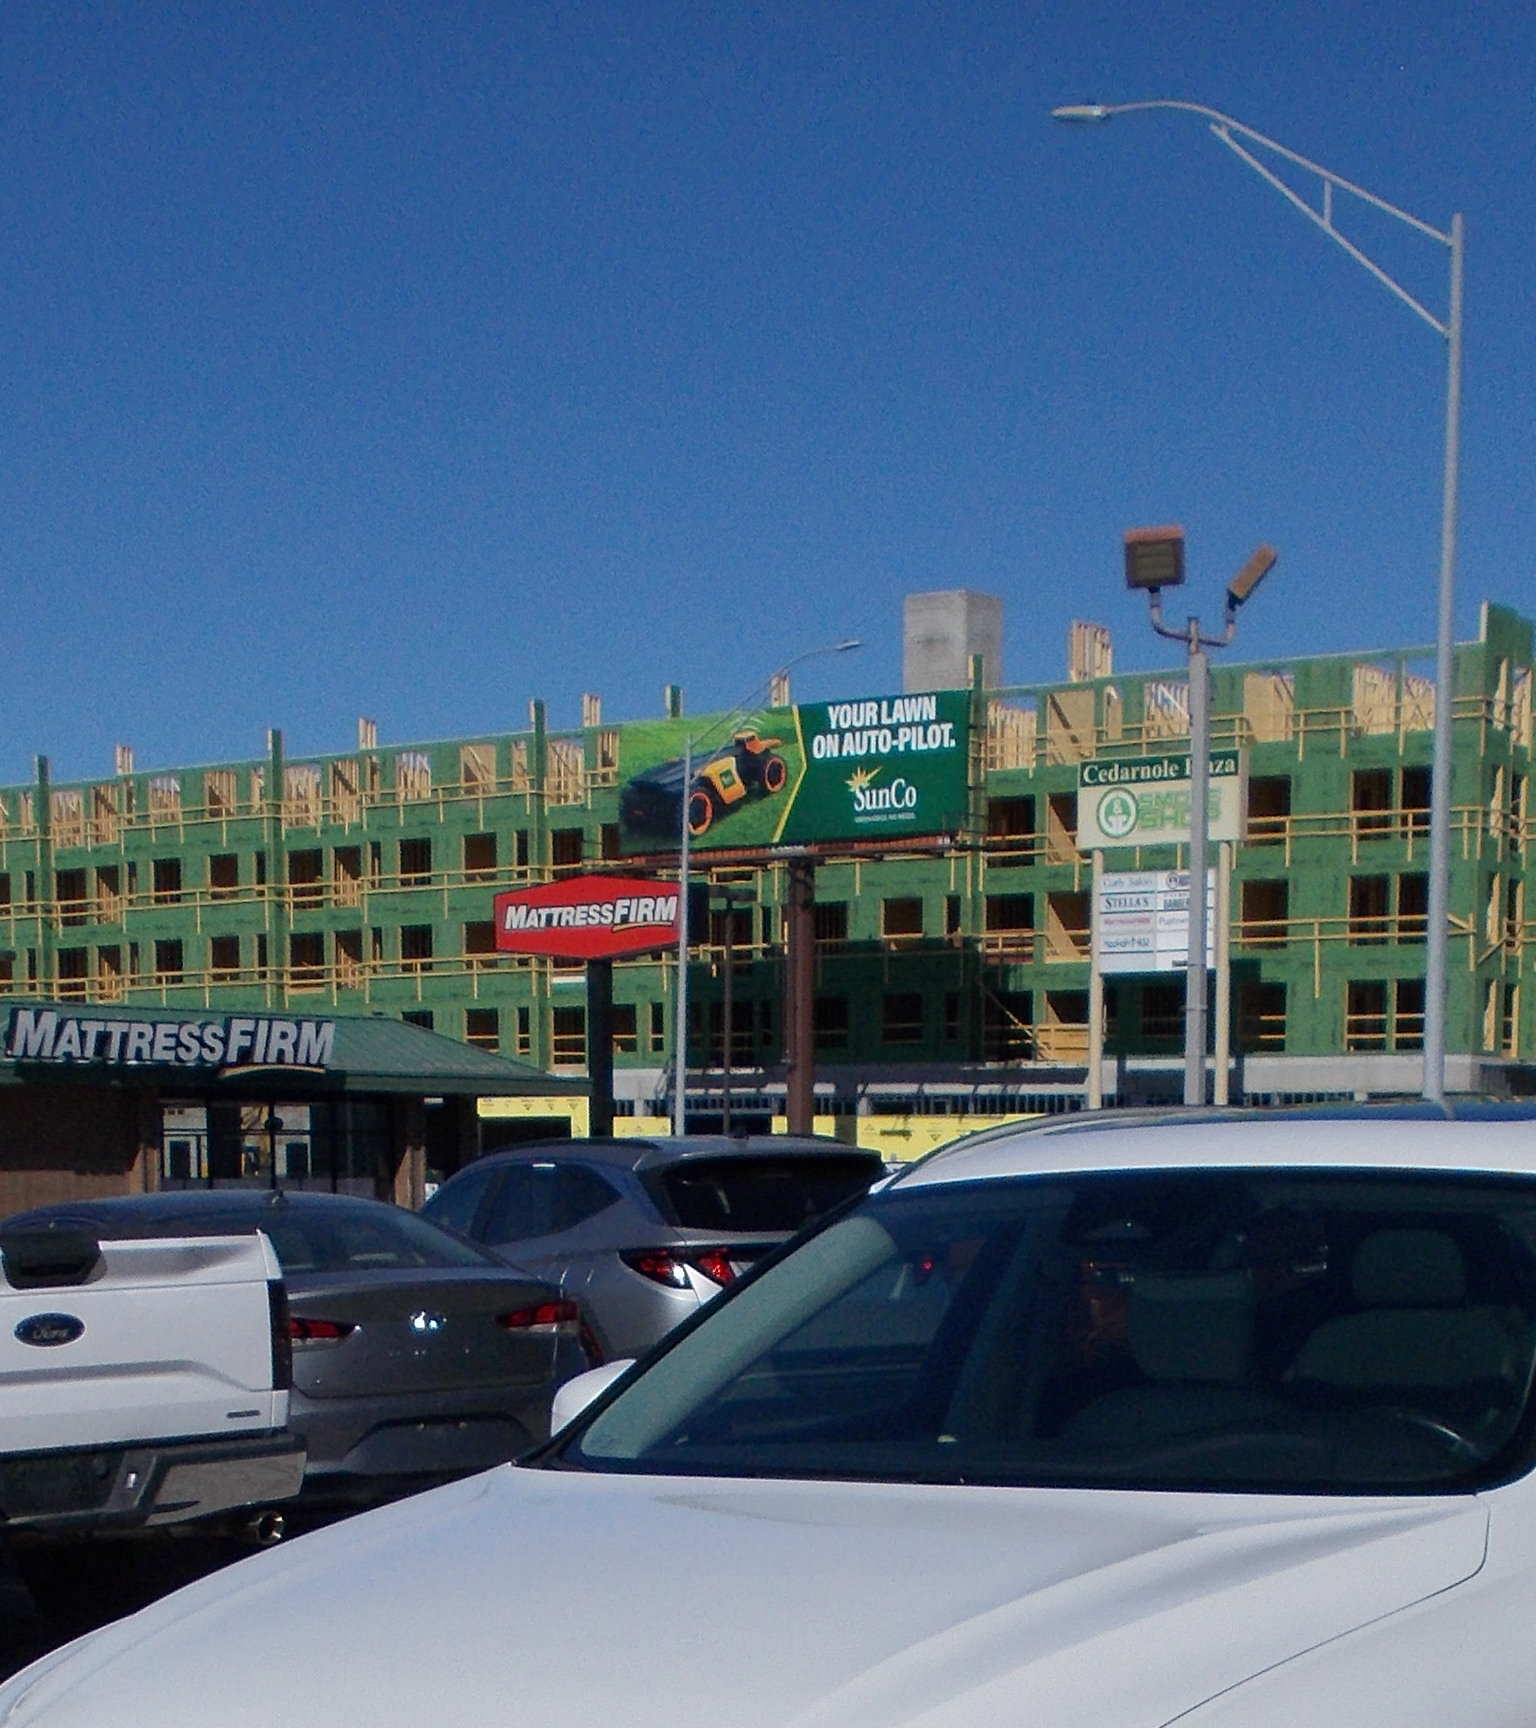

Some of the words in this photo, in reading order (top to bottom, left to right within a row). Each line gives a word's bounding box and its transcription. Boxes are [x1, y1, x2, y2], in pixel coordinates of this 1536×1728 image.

[828, 701, 878, 730] YOUR
[881, 695, 937, 724] LAWN
[813, 733, 840, 759] ON
[841, 722, 956, 756] AUTO-PILOT.
[1082, 760, 1180, 784] Cedarnole
[853, 778, 917, 812] SunCo
